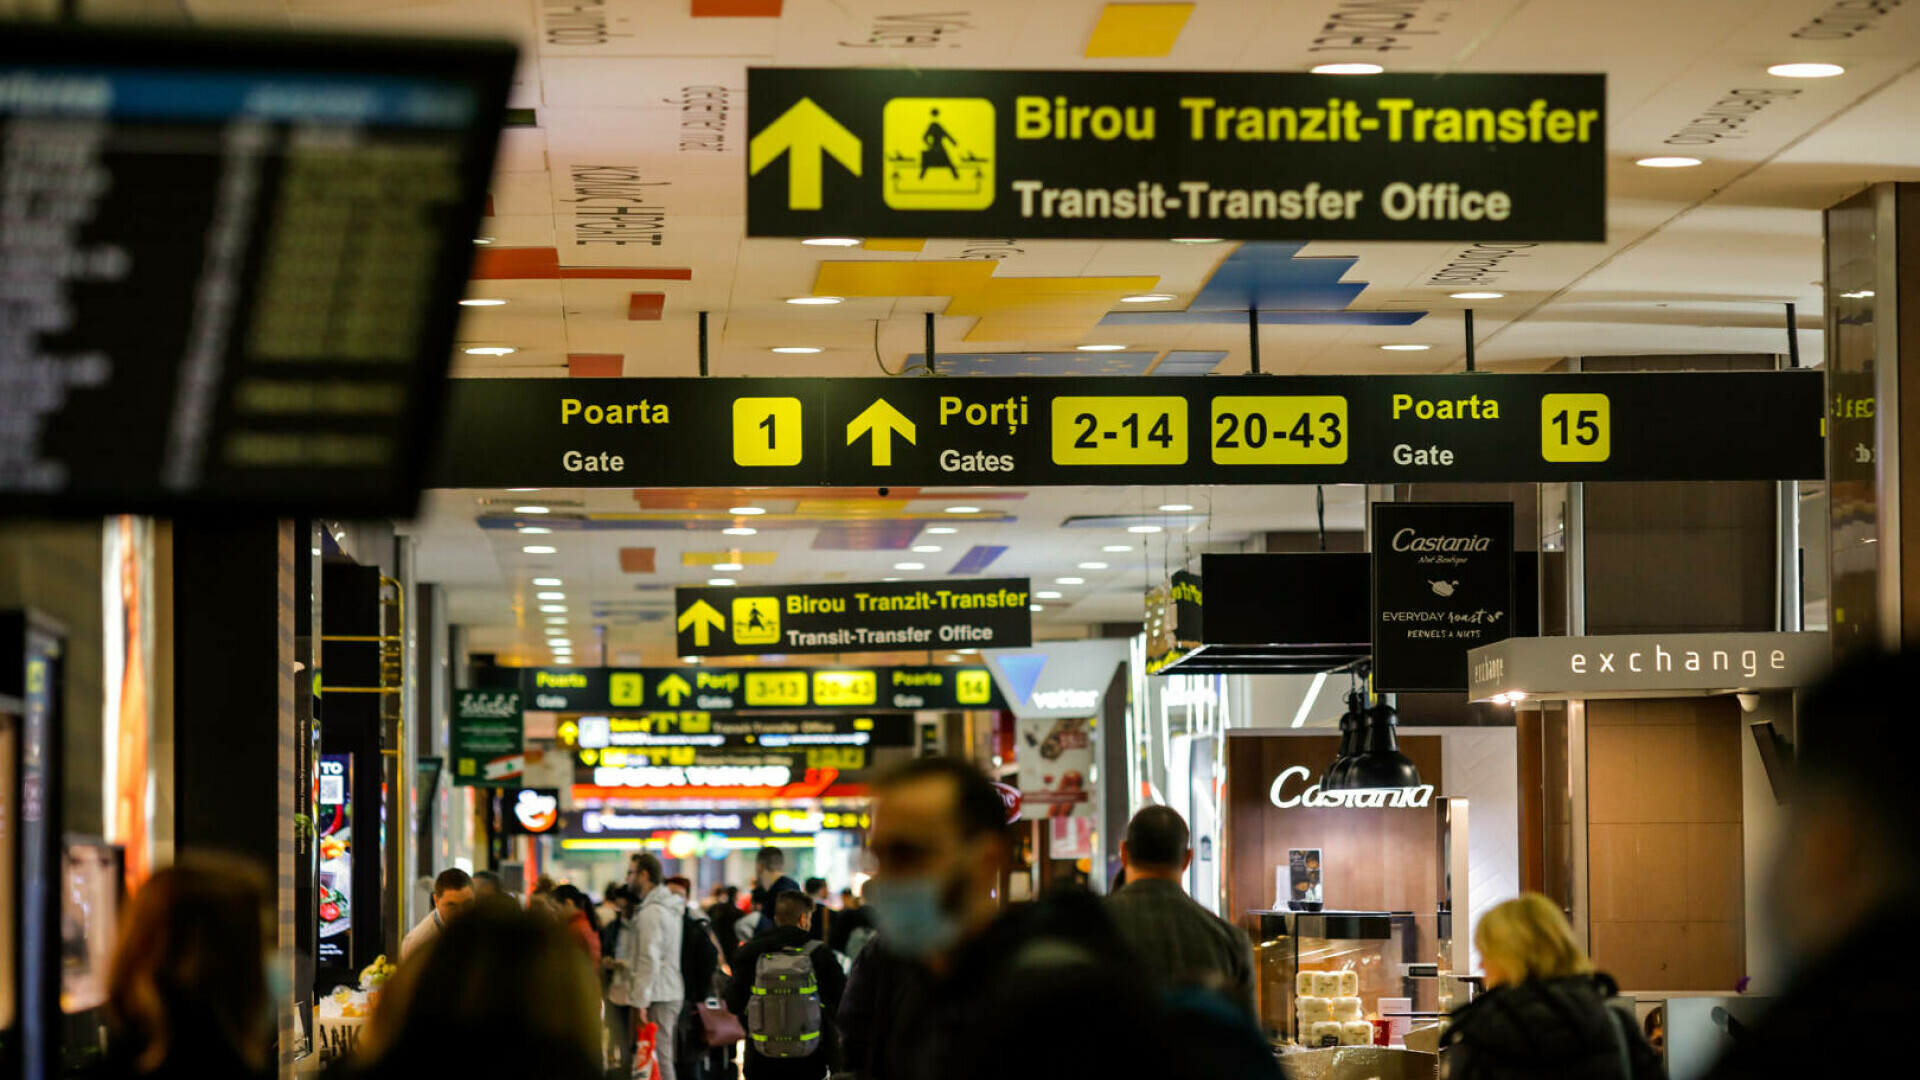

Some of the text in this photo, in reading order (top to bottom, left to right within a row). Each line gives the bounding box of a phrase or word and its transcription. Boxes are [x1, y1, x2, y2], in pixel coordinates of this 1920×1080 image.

[1015, 97, 1599, 145] Birou Tranzit-Transfer
[1012, 181, 1512, 221] Transit-Transfer Office
[560, 398, 776, 449] Poarta 1
[939, 396, 1342, 449] Porți 2-14 20-43
[1392, 393, 1600, 445] Poarta 15
[563, 451, 625, 472] Gate
[939, 450, 1015, 472] Gates
[1393, 444, 1454, 466] Gate
[1392, 527, 1491, 552] Castania
[787, 589, 1028, 614] Birou Tranzit-Transfer
[1382, 611, 1445, 622] EVERYDAY
[787, 625, 993, 646] Transit-Transfer Office
[1456, 629, 1482, 639] NUTS
[1571, 644, 1786, 678] exchange
[536, 671, 634, 699] Poarta 2
[756, 680, 799, 698] 3-13
[892, 671, 985, 697] Poarta 14
